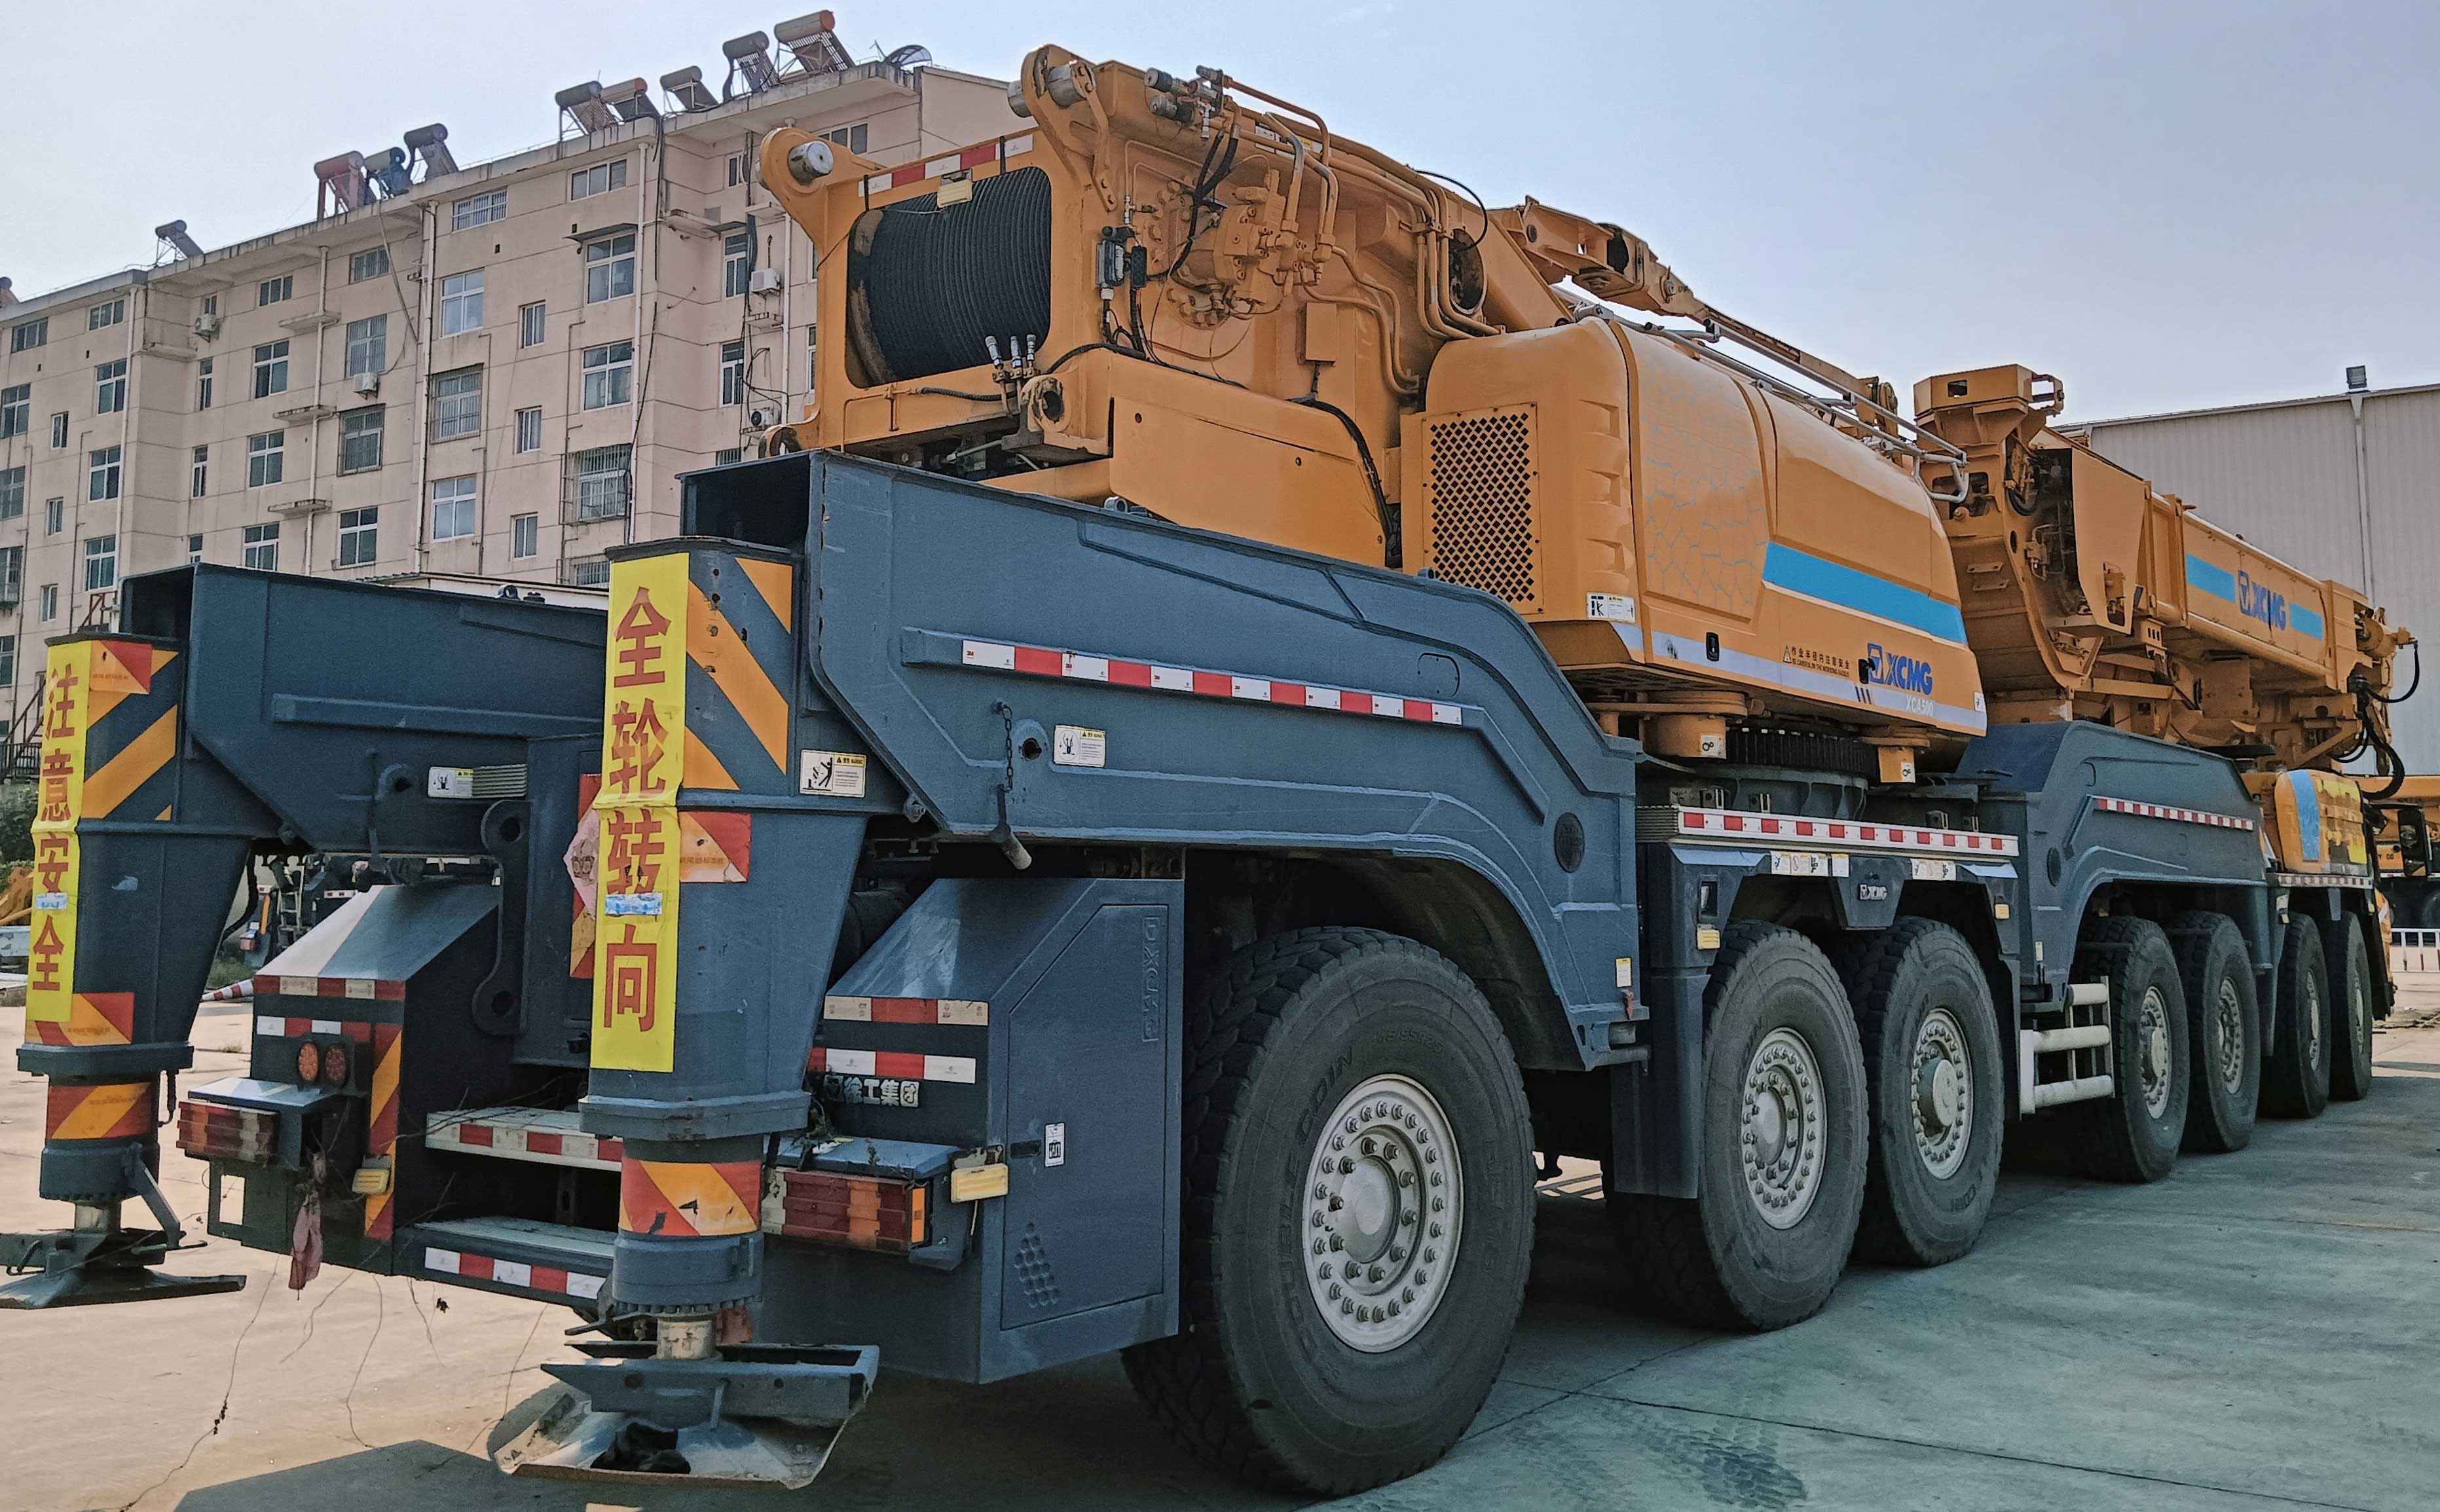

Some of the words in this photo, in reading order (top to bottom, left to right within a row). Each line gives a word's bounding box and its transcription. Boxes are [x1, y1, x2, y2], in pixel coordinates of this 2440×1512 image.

[2251, 581, 2286, 631] XCMG
[1885, 652, 1932, 695] XCMG
[1906, 695, 1934, 717] XCA500
[33, 663, 79, 991] 注意安全
[604, 586, 671, 1033] 全轮转向
[843, 1077, 919, 1107] 徐工集团
[1295, 1046, 1354, 1146] COIN
